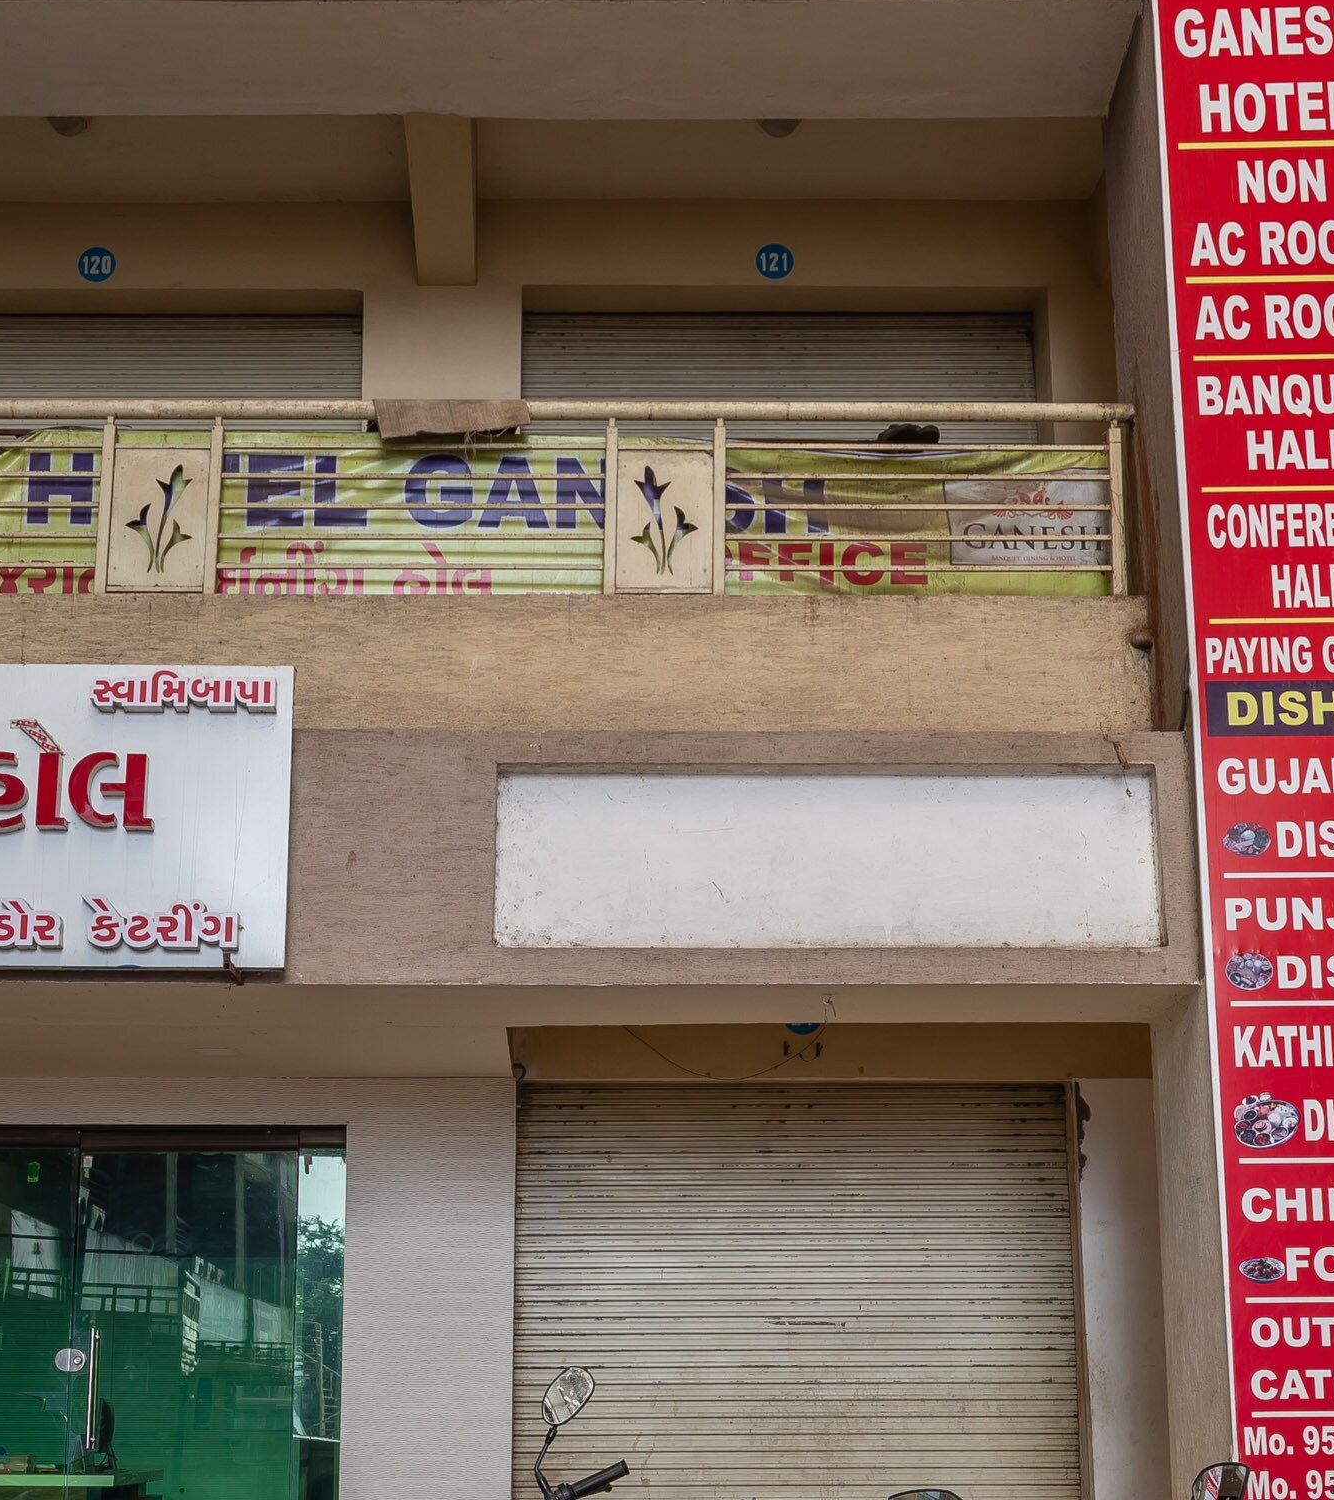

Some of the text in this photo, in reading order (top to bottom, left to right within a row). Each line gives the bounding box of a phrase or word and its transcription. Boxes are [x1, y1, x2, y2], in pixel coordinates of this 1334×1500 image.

[1237, 158, 1327, 204] NON
[759, 252, 788, 272] 121
[1190, 221, 1246, 266] AC
[82, 254, 112, 275] 120
[1195, 294, 1251, 340] AC
[963, 522, 1105, 551] GANESH
[1205, 636, 1313, 674] PAYING
[91, 670, 277, 713] સ્વામિબાપા
[82, 894, 240, 952] કેટરીંગ
[1243, 1426, 1294, 1456] Mo.
[1247, 1469, 1297, 1500] Mo.
